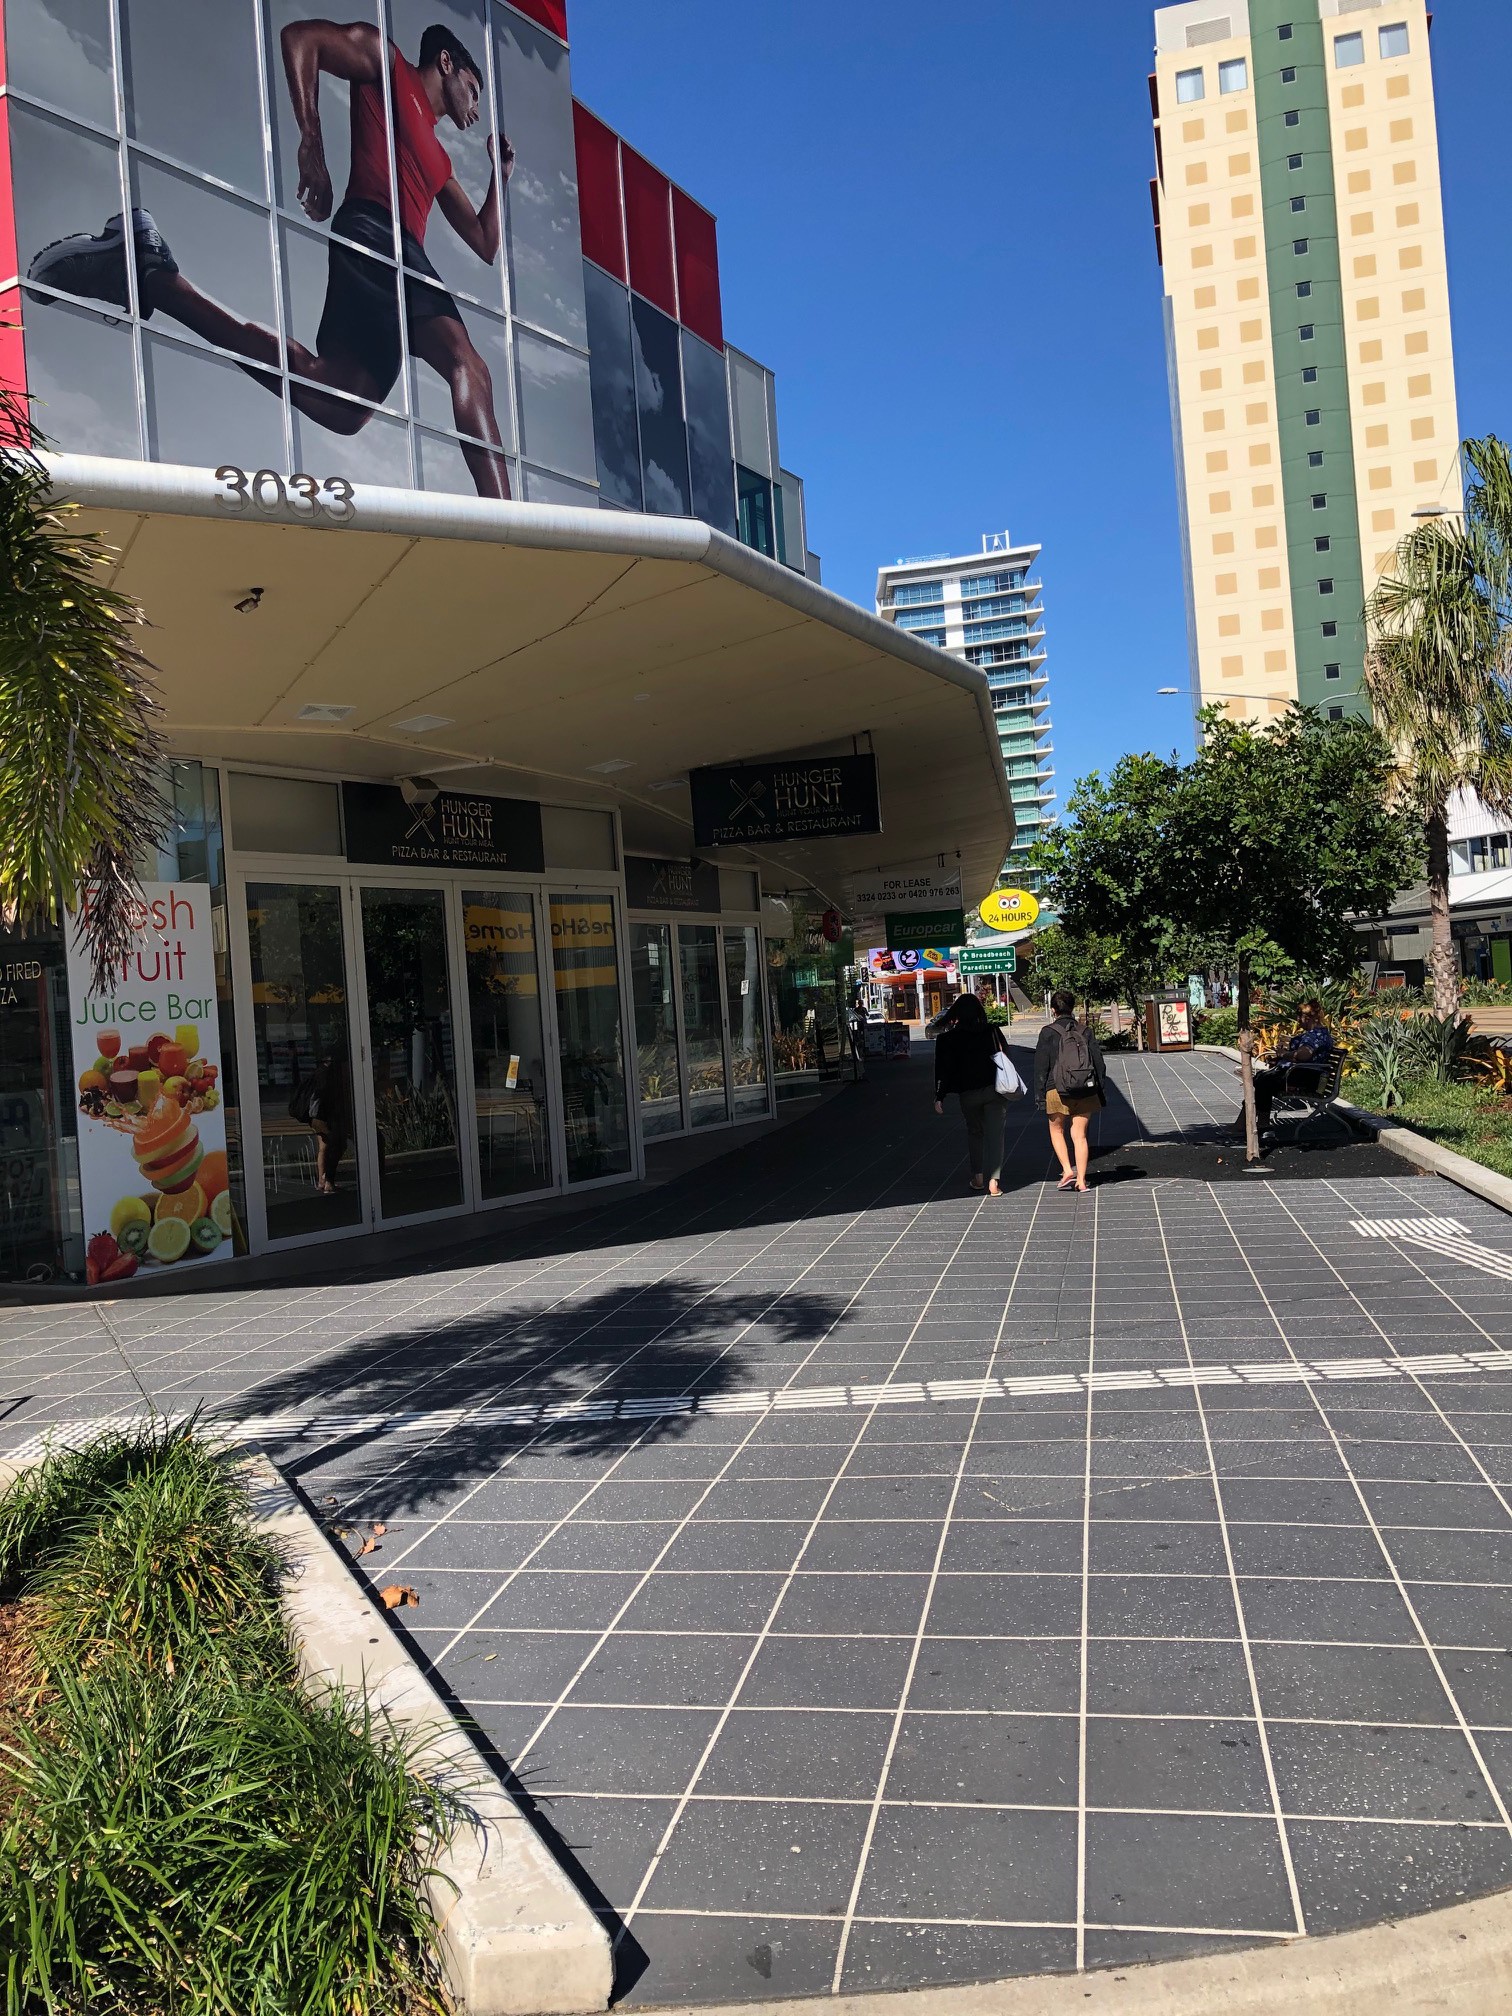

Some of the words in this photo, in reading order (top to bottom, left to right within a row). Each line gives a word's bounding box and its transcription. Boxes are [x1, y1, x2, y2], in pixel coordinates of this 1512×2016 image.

[214, 465, 357, 522] 3033
[774, 767, 842, 787] HUNGER
[774, 782, 843, 810] HUNT
[441, 799, 492, 818] HUNGER
[442, 814, 494, 839] HUNT
[713, 827, 744, 839] PIZZA
[747, 823, 771, 836] BAR
[775, 822, 784, 834] &
[787, 814, 862, 832] RESTAURANT
[392, 845, 418, 859] PIZZA
[420, 848, 440, 860] BAR
[442, 850, 450, 860] &
[452, 850, 508, 863] RESTAURANT
[668, 875, 692, 891] HUNT
[883, 880, 901, 890] FOR
[903, 878, 931, 888] LEASE
[857, 892, 876, 902] 3324
[877, 891, 896, 901] 0233
[908, 888, 928, 898] 0420
[929, 888, 944, 897] 976
[945, 886, 960, 895] 263
[83, 888, 194, 930] Fesh
[988, 914, 999, 923] 24
[1001, 912, 1033, 922] HOURS
[893, 922, 957, 938] Europcar
[98, 941, 187, 982] ruit
[970, 951, 1011, 959] Broadbeach
[6, 961, 42, 982] FIRED
[962, 963, 993, 971] Paradise
[76, 994, 157, 1025] Juice
[167, 993, 213, 1020] Bar
